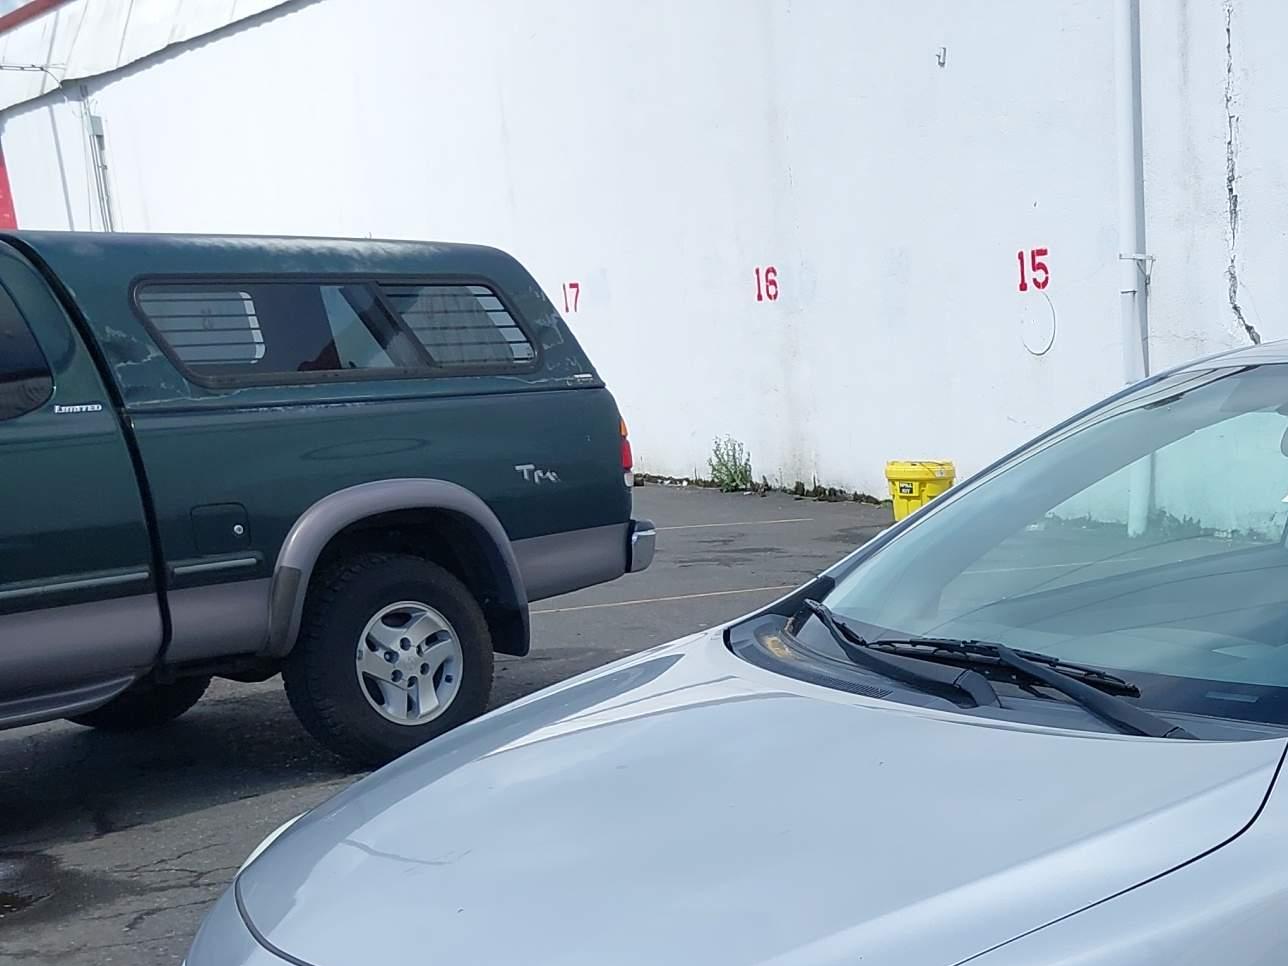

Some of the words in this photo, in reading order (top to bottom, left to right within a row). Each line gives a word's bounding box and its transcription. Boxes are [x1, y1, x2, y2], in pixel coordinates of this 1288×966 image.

[755, 266, 779, 303] 16
[1016, 247, 1050, 293] 15
[562, 281, 581, 314] 17
